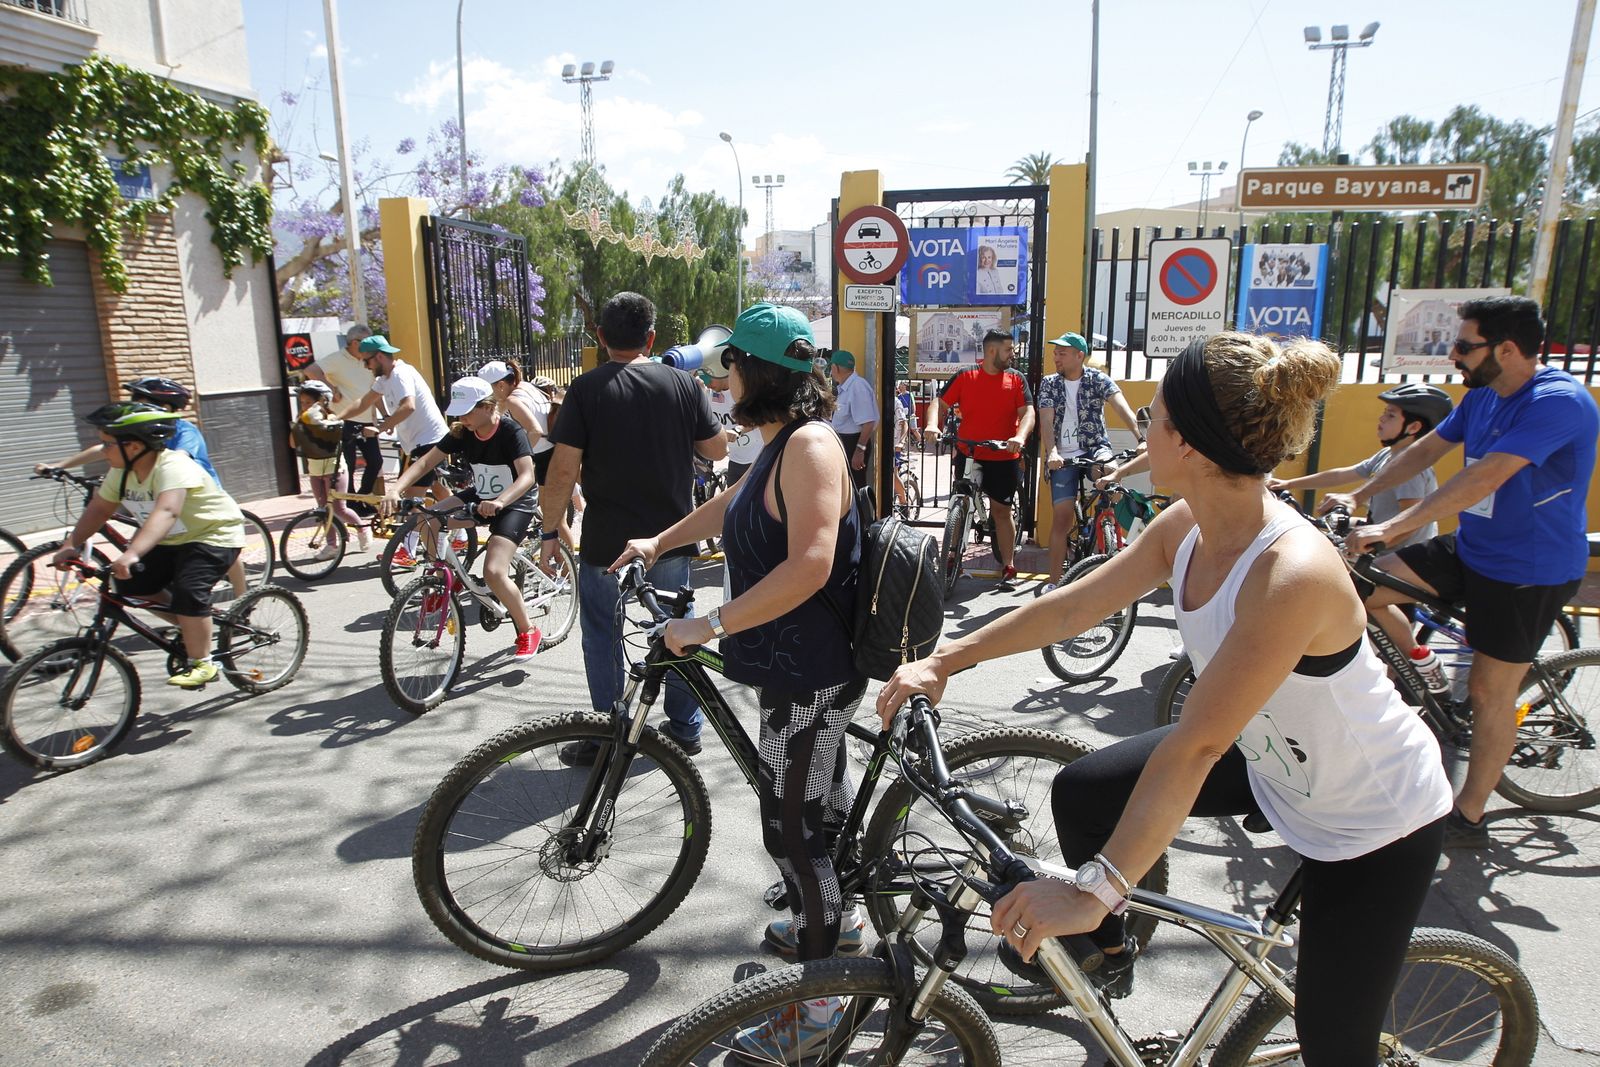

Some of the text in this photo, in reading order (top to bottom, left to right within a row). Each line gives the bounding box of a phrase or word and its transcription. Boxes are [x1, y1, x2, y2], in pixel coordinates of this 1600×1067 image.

[1247, 179, 1324, 198] Parque
[910, 238, 965, 258] VOTA
[1151, 311, 1222, 320] MERCADILLO
[1249, 306, 1312, 328] VOTA
[918, 363, 941, 372] Nuevos
[478, 474, 504, 495] 26
[1373, 631, 1422, 691] ROCKRIDER
[1440, 953, 1513, 984] MAXXIS
